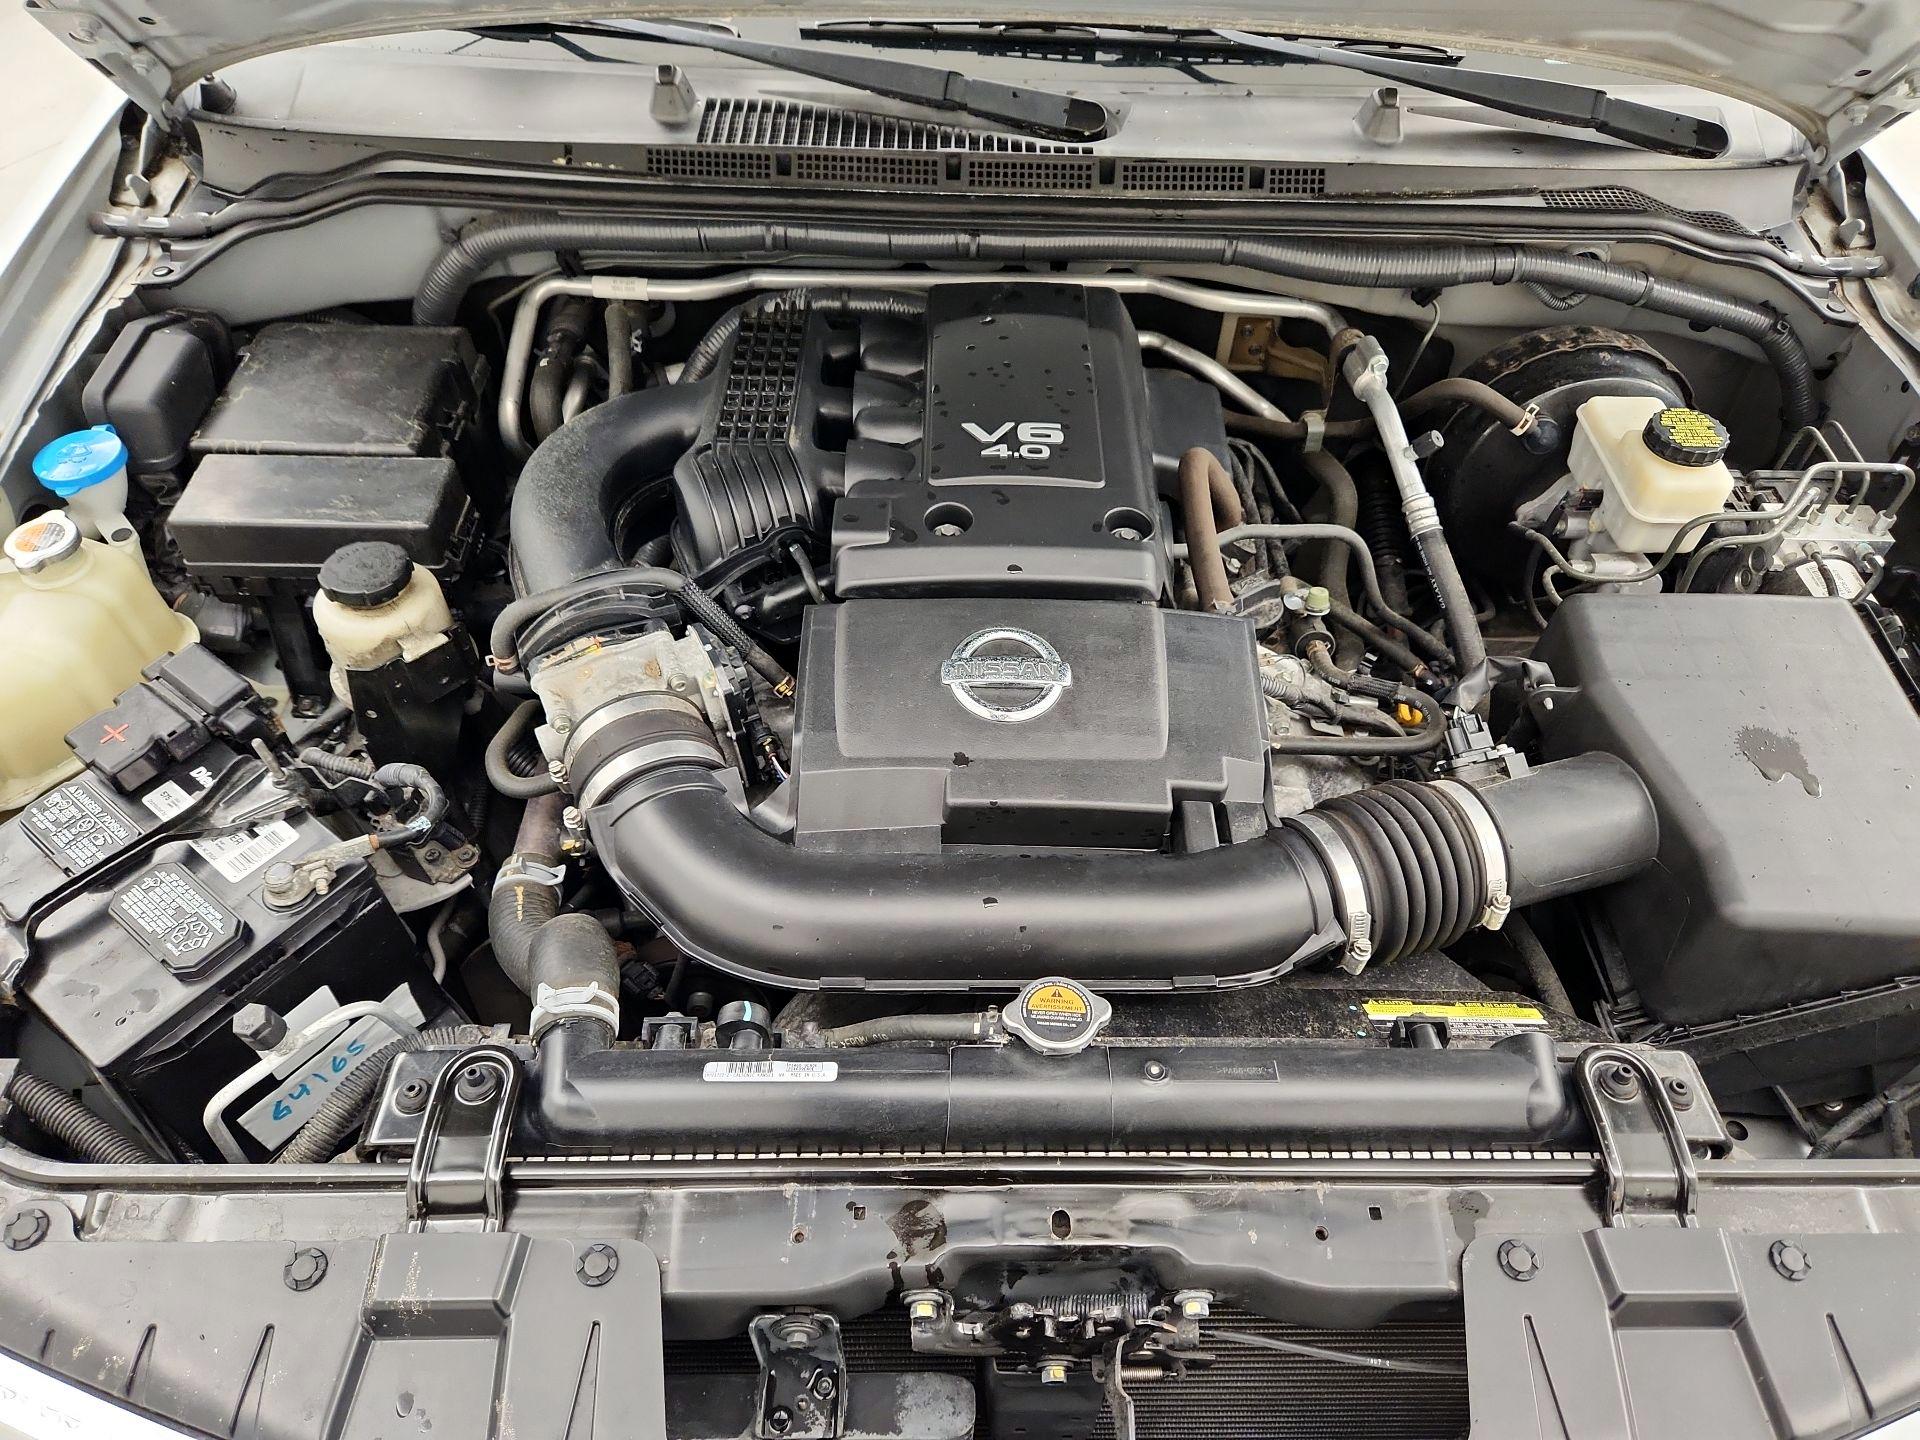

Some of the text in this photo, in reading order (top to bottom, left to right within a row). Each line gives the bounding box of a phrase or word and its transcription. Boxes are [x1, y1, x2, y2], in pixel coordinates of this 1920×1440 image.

[961, 422, 1064, 444] V6
[980, 444, 1050, 459] 4.0
[953, 660, 1060, 681] NISSAN
[189, 766, 214, 789] Die
[73, 789, 103, 816] DANGER
[100, 815, 130, 840] POISON
[1031, 1003, 1083, 1012] AVERTISSEMENT
[1039, 997, 1074, 1005] WARNING
